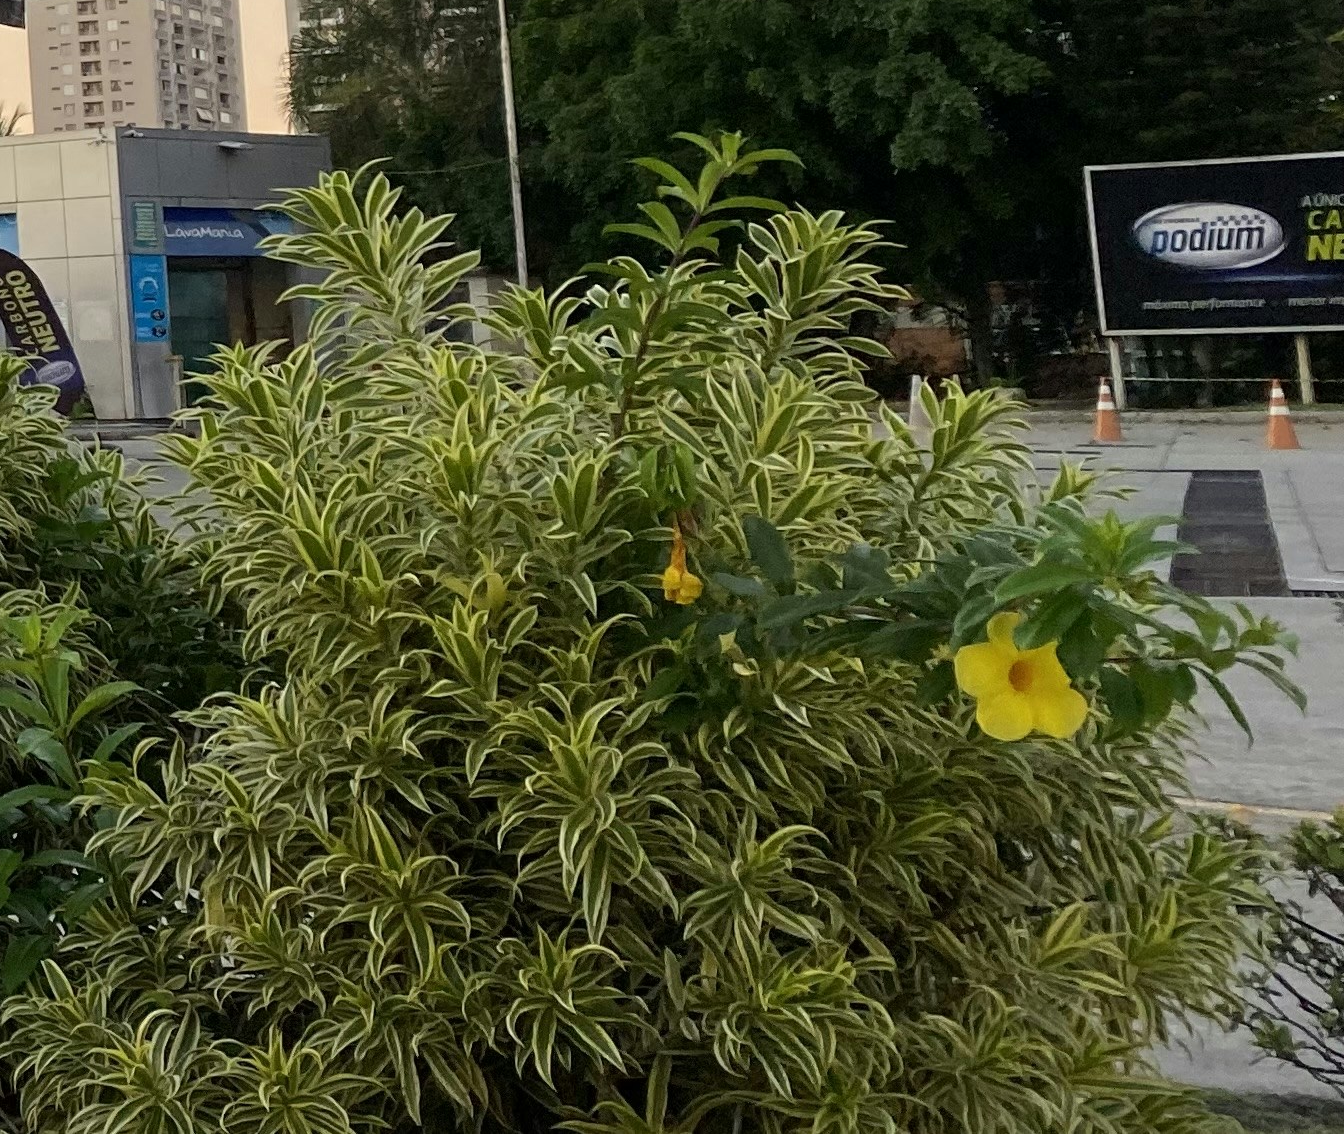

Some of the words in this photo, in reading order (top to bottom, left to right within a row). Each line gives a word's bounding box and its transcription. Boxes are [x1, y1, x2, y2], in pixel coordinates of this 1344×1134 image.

[164, 224, 244, 239] LavaMania
[1150, 222, 1265, 255] podium
[6, 269, 61, 354] NEUTRO
